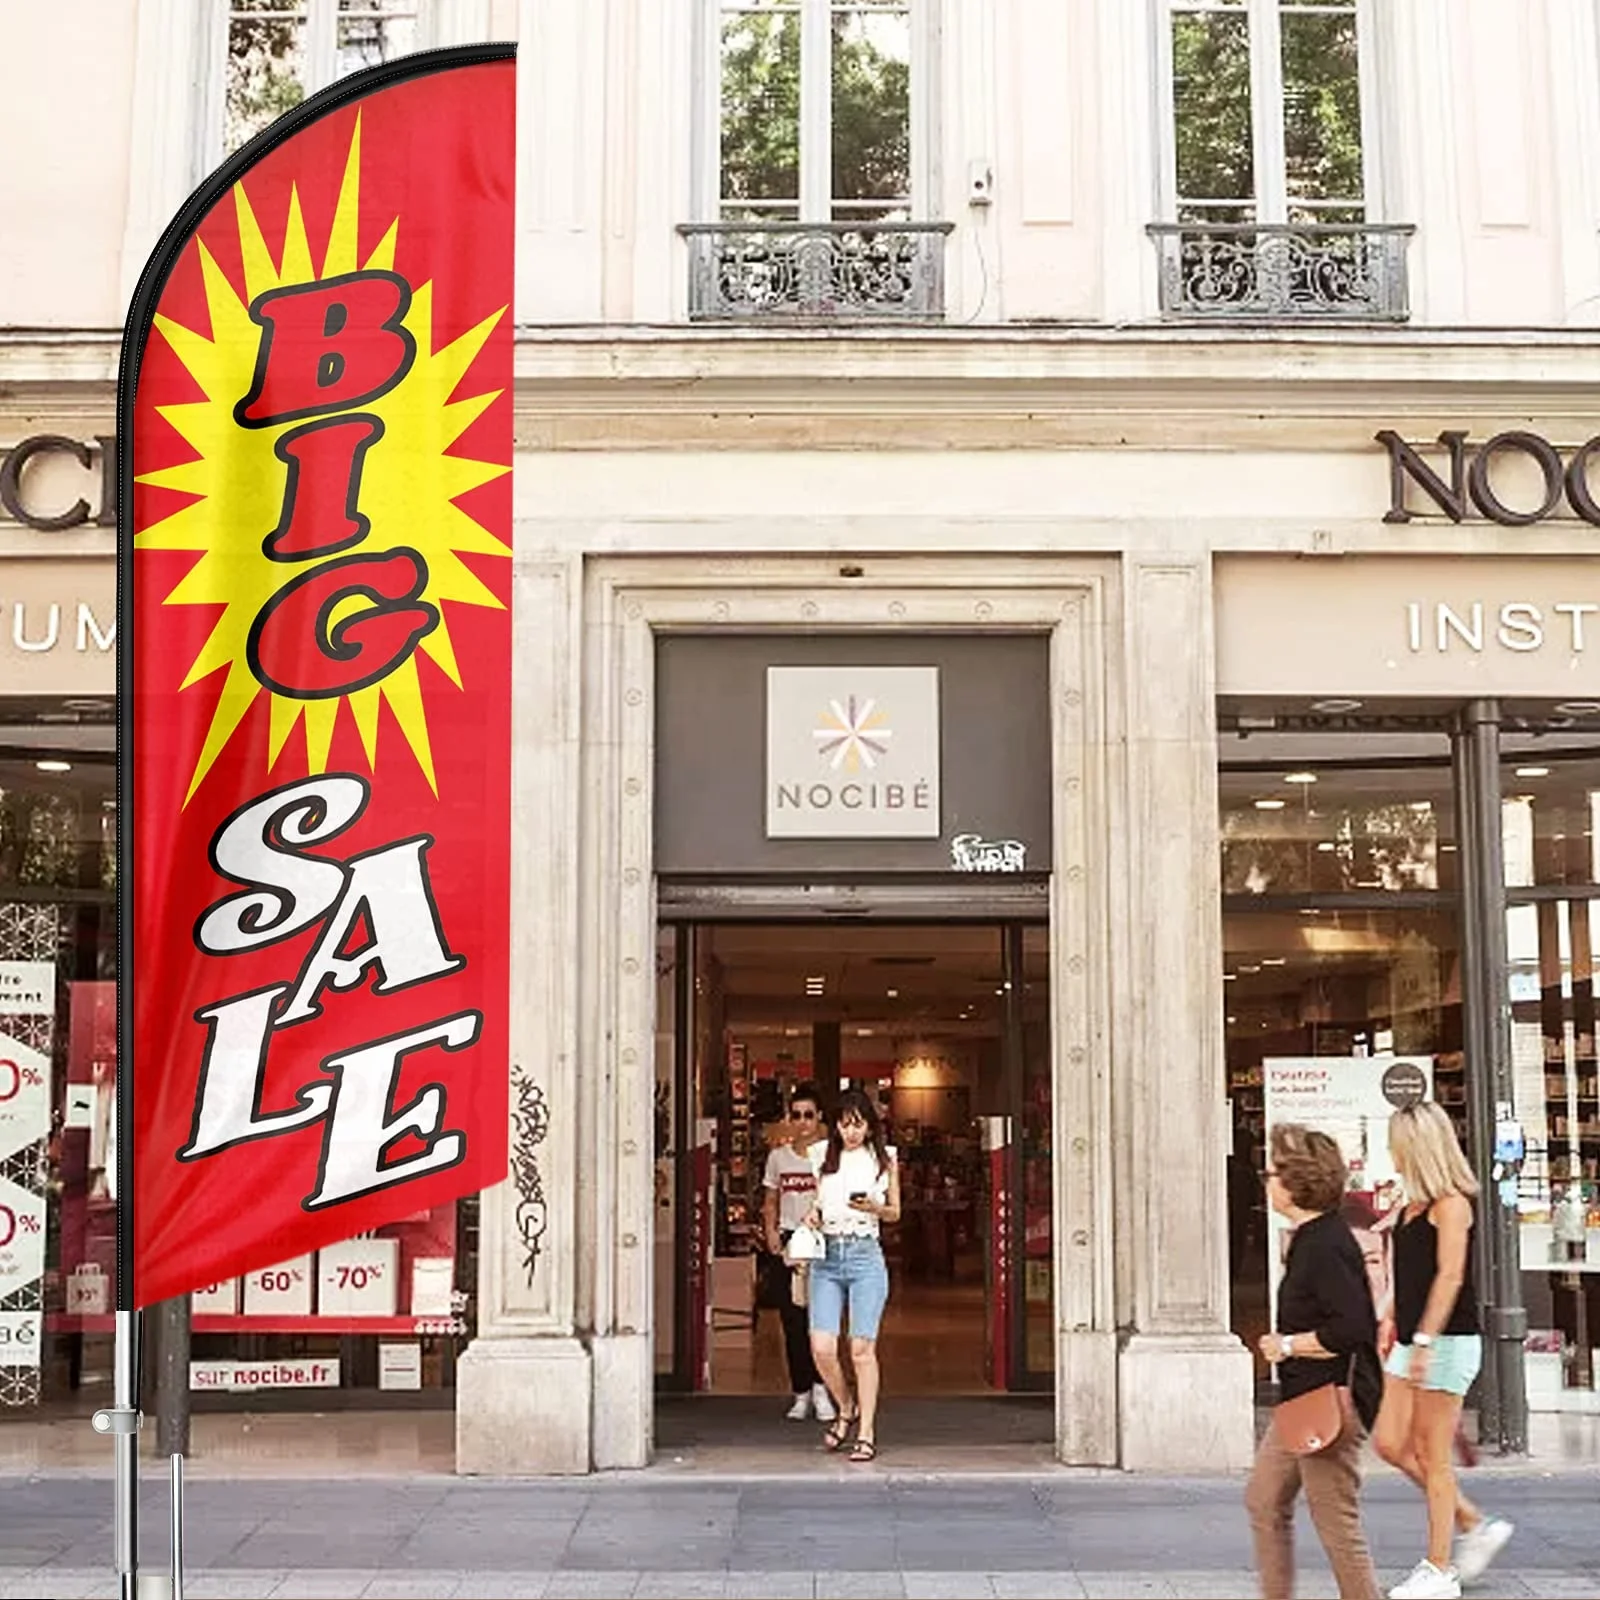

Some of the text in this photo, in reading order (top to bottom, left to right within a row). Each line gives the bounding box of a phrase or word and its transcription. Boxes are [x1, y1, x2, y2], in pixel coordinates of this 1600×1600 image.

[233, 269, 440, 700] BIG
[1408, 602, 1599, 653] INST
[776, 777, 930, 809] NOCIBÉ
[175, 771, 484, 1213] SALE
[195, 1365, 330, 1386] sur nocibe.fr
